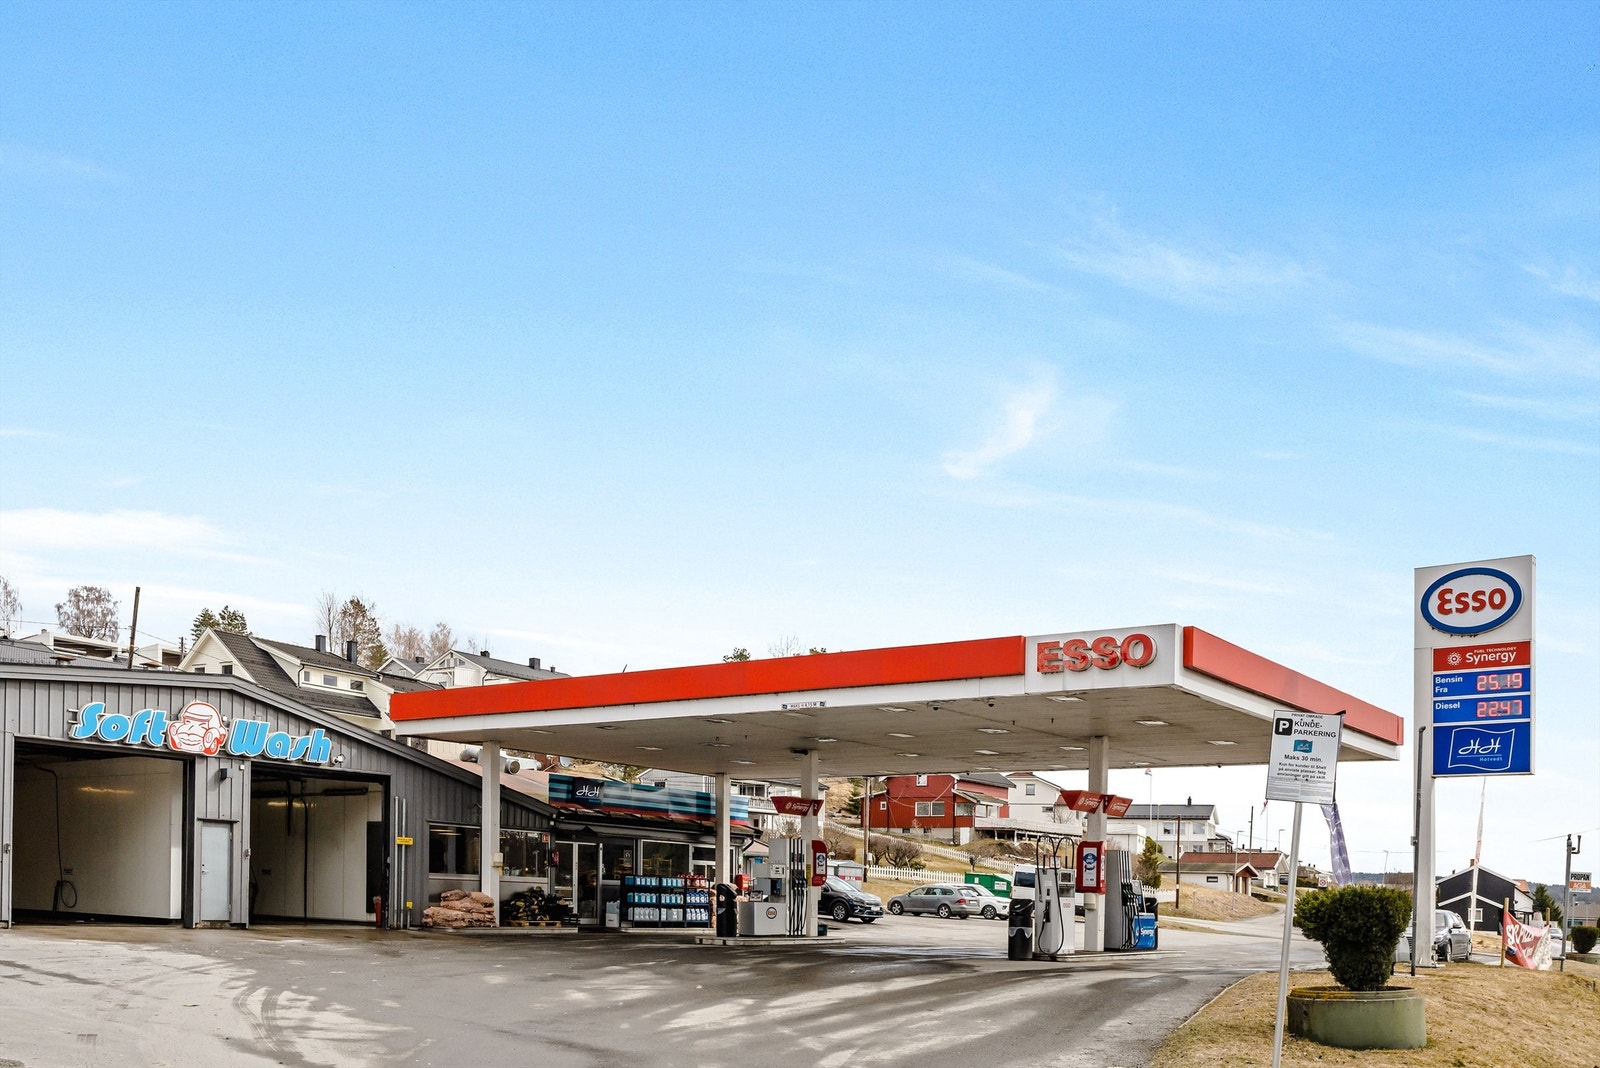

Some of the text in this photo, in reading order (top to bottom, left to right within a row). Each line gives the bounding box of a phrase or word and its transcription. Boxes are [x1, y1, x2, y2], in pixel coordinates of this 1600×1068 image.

[1036, 633, 1155, 673] ESSO
[1465, 652, 1517, 665] Synergy
[1435, 672, 1522, 691] Bensin 25.19
[1435, 702, 1460, 710] Diesel
[1278, 720, 1290, 732] P
[1294, 720, 1322, 728] KUNDE-
[73, 702, 332, 763] Soft Wash
[1293, 729, 1336, 738] PARKERING
[1084, 798, 1100, 808] Synergy
